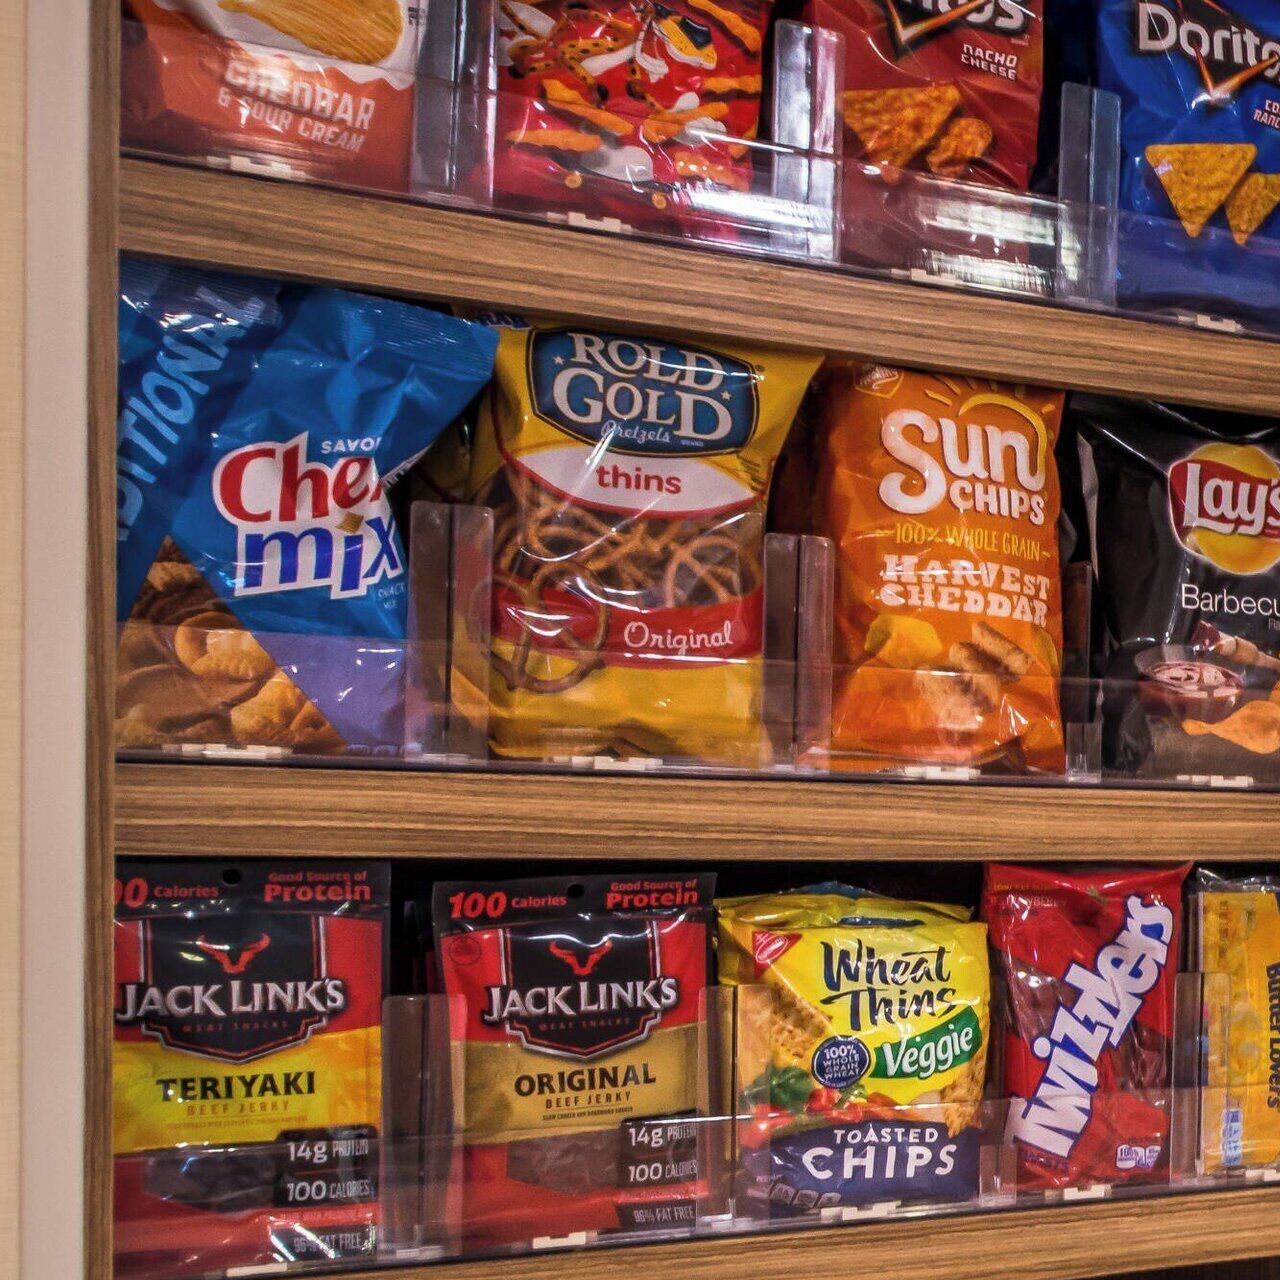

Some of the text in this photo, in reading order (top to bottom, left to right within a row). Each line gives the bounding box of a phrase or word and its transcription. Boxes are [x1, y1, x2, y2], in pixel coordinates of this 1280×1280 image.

[960, 54, 1018, 81] CHEESE
[963, 43, 1018, 68] NACHO
[298, 117, 366, 152] CREAM
[567, 332, 725, 391] ROLD
[553, 366, 734, 441] GOLD
[879, 408, 1046, 515] Sun
[596, 464, 683, 494] thins
[950, 479, 1046, 526] CHIPS
[244, 515, 400, 594] mix
[946, 524, 998, 552] WHOLE
[1002, 530, 1040, 562] GRAIN
[879, 554, 1051, 600] HARVEST
[879, 583, 1049, 628] CHEDDAR
[623, 621, 734, 652] Original
[268, 870, 367, 882] Good Source of
[610, 878, 698, 892] Good Source of
[154, 886, 220, 898] Calories
[264, 880, 371, 903] Protein
[606, 890, 698, 910] Protein
[450, 892, 567, 919] 100 Calories
[820, 939, 952, 992] Wheat
[116, 977, 346, 1021] JACK LINK'S
[484, 978, 678, 1021] JACK LINK'S
[820, 987, 957, 1031] Thins
[823, 1054, 860, 1067] WHOLE
[824, 1045, 857, 1059] 100%
[882, 1023, 974, 1079] Veggie
[513, 1062, 657, 1097] ORIGINAL
[824, 1069, 860, 1081] WHEAT
[825, 1062, 859, 1074] GRAIN
[156, 1070, 316, 1102] TERIYAKI
[187, 1100, 290, 1116] BEEF JERKY
[546, 1090, 631, 1110] BEEF JERKY
[629, 1127, 664, 1147] 14g
[834, 1123, 939, 1145] TOASTED
[288, 1141, 329, 1164] 14g
[802, 1144, 958, 1180] CHIPS
[628, 1162, 663, 1183] 100
[287, 1180, 327, 1202] 100
[656, 1206, 695, 1222] FAT FREE
